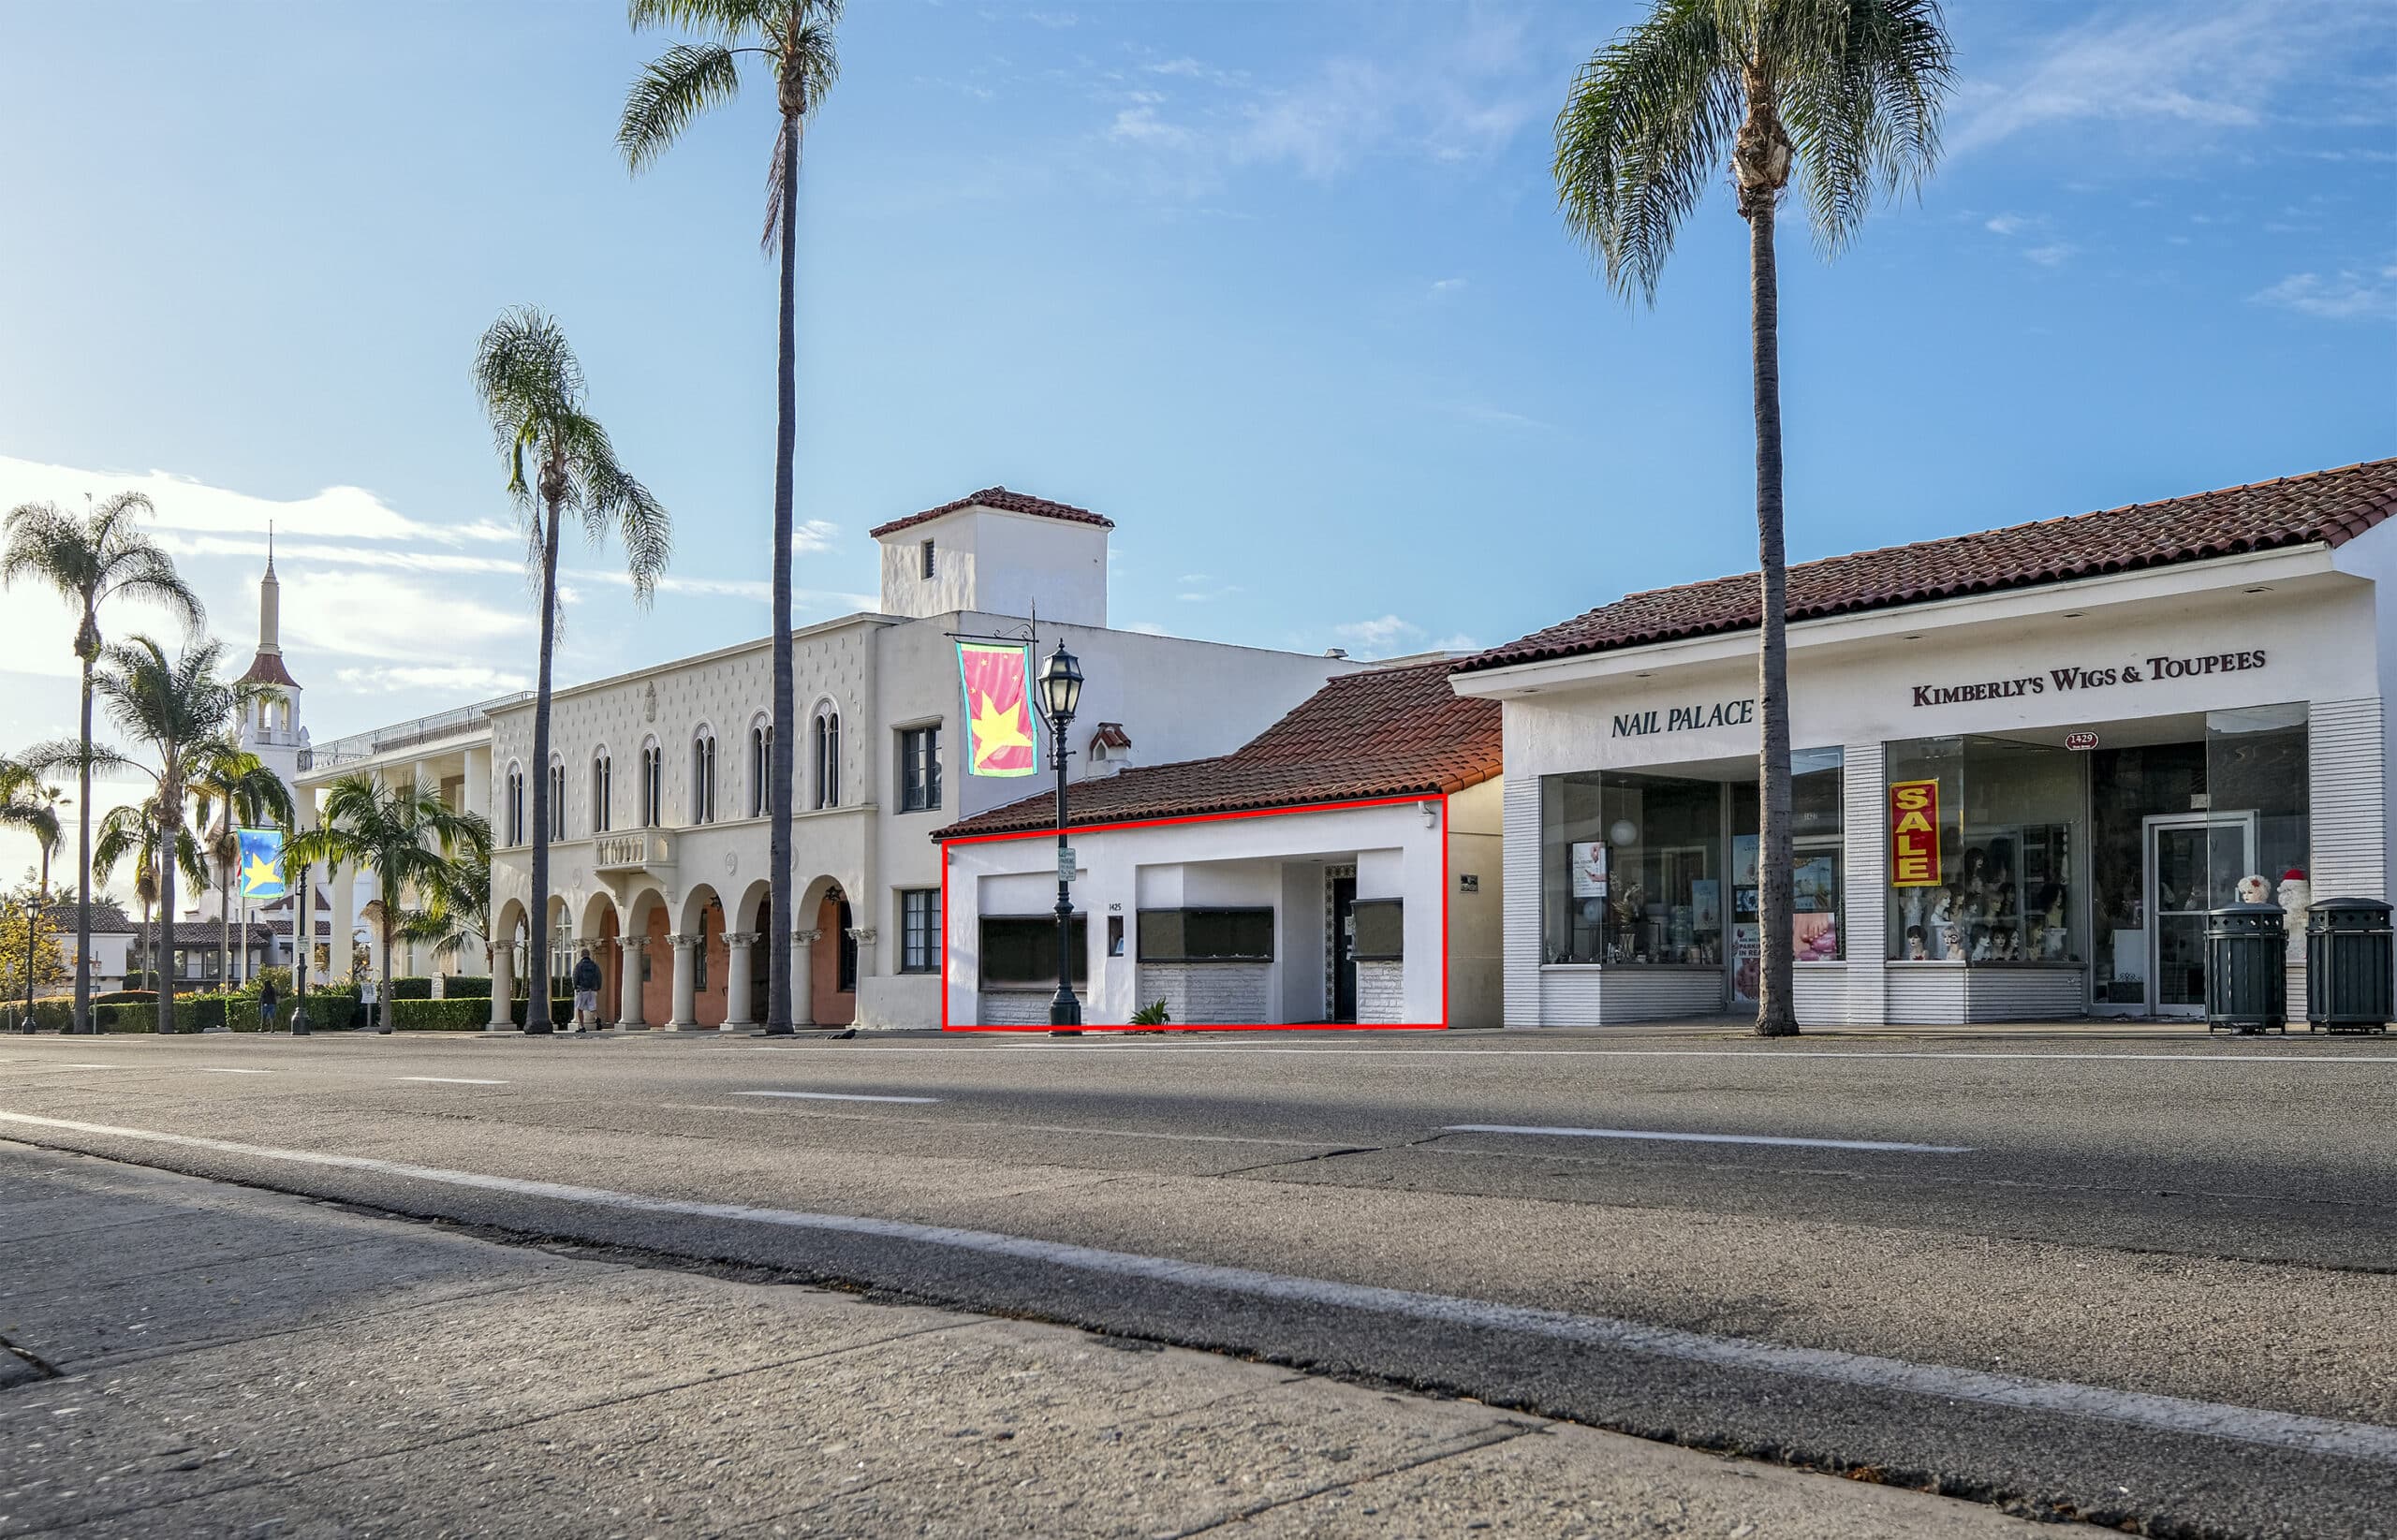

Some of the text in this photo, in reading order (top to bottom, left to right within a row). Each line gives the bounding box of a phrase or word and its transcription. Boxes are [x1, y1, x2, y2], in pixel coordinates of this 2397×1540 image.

[2121, 666, 2143, 684] &
[1611, 699, 1755, 739] NAIL PALACE
[2070, 734, 2093, 743] 1429
[1895, 787, 1934, 880] SALE
[1109, 902, 1122, 912] 1425
